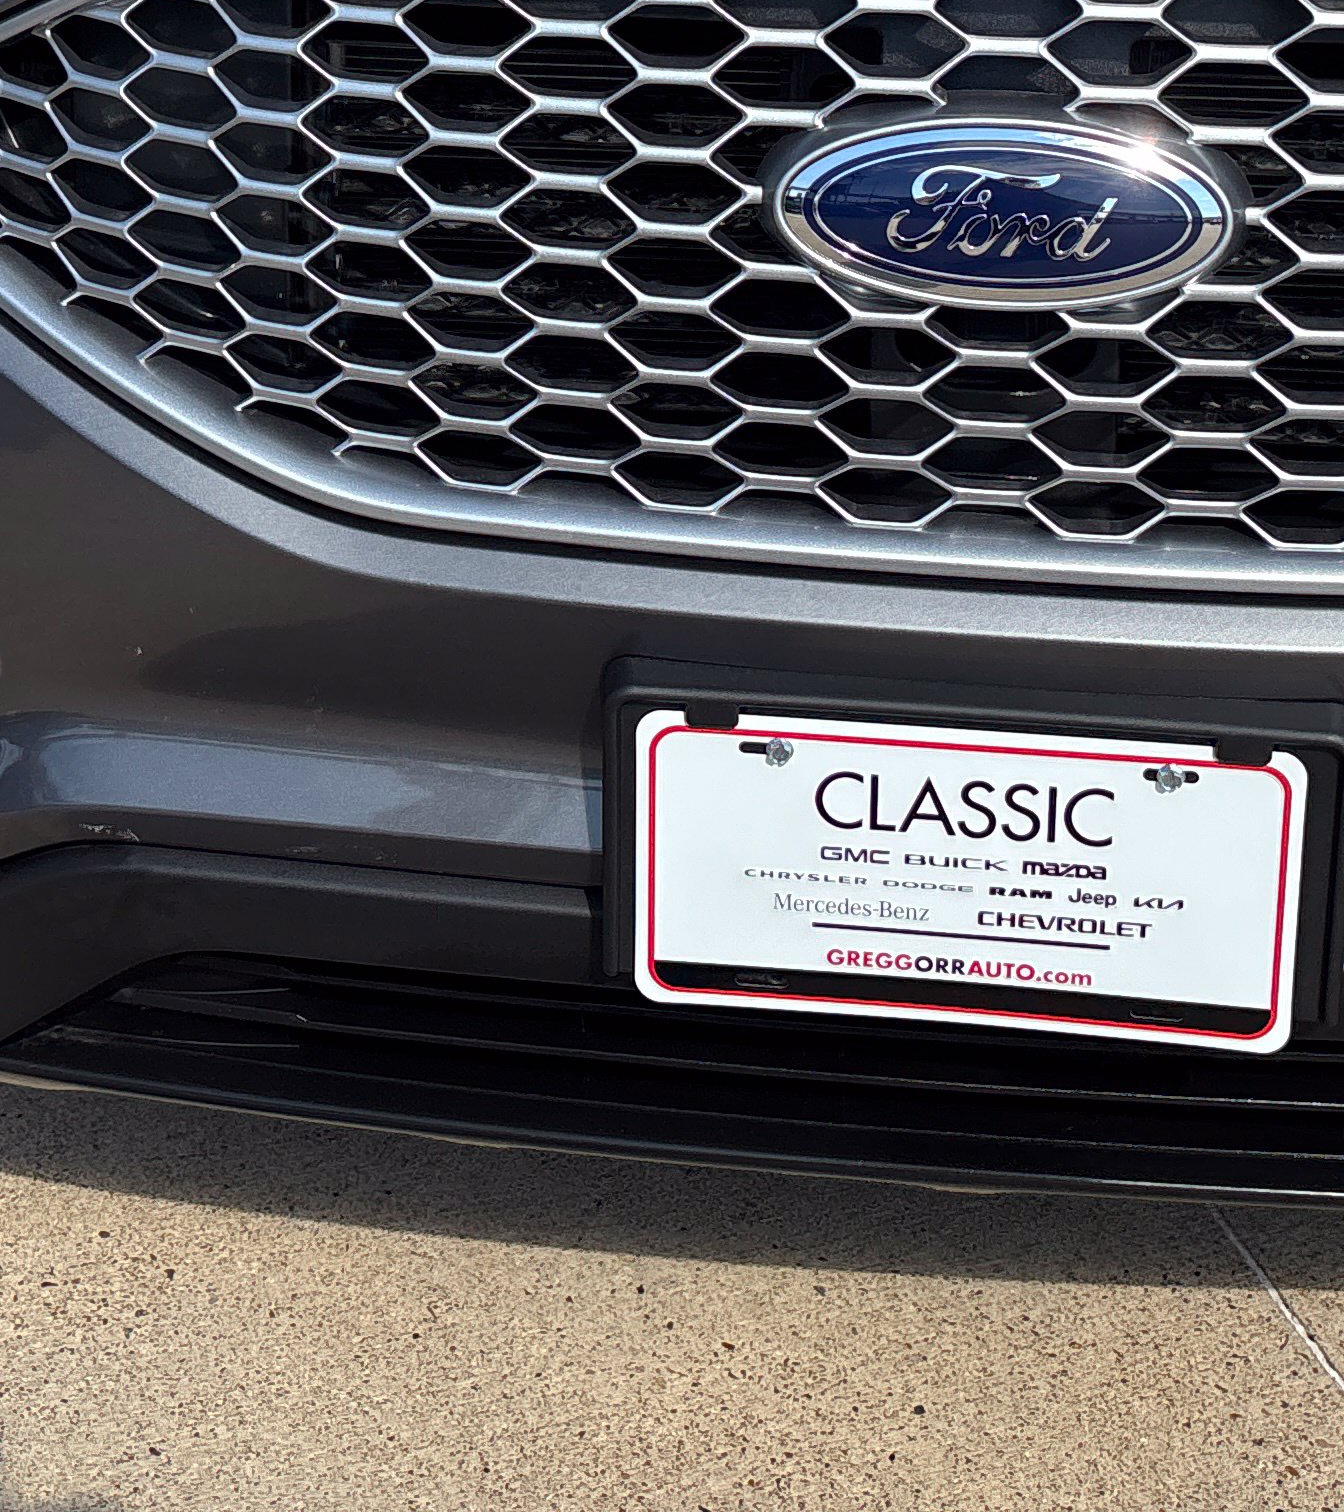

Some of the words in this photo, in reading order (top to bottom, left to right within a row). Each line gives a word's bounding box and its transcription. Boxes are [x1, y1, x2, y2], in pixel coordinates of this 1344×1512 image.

[886, 165, 1118, 262] Ford
[815, 770, 1116, 848] CLASSIC
[820, 845, 891, 866] GMC
[904, 853, 1009, 873] BUICK
[744, 867, 868, 887] CHRYSLER
[882, 878, 975, 894] DODGE
[988, 885, 1054, 901] RAM
[1067, 887, 1118, 909] Jeep
[1133, 894, 1185, 911] KIA
[773, 893, 930, 922] Mercedes-Benz
[977, 910, 1153, 939] CHEVROLET
[826, 948, 1093, 988] GREGGORRAUTO.com
